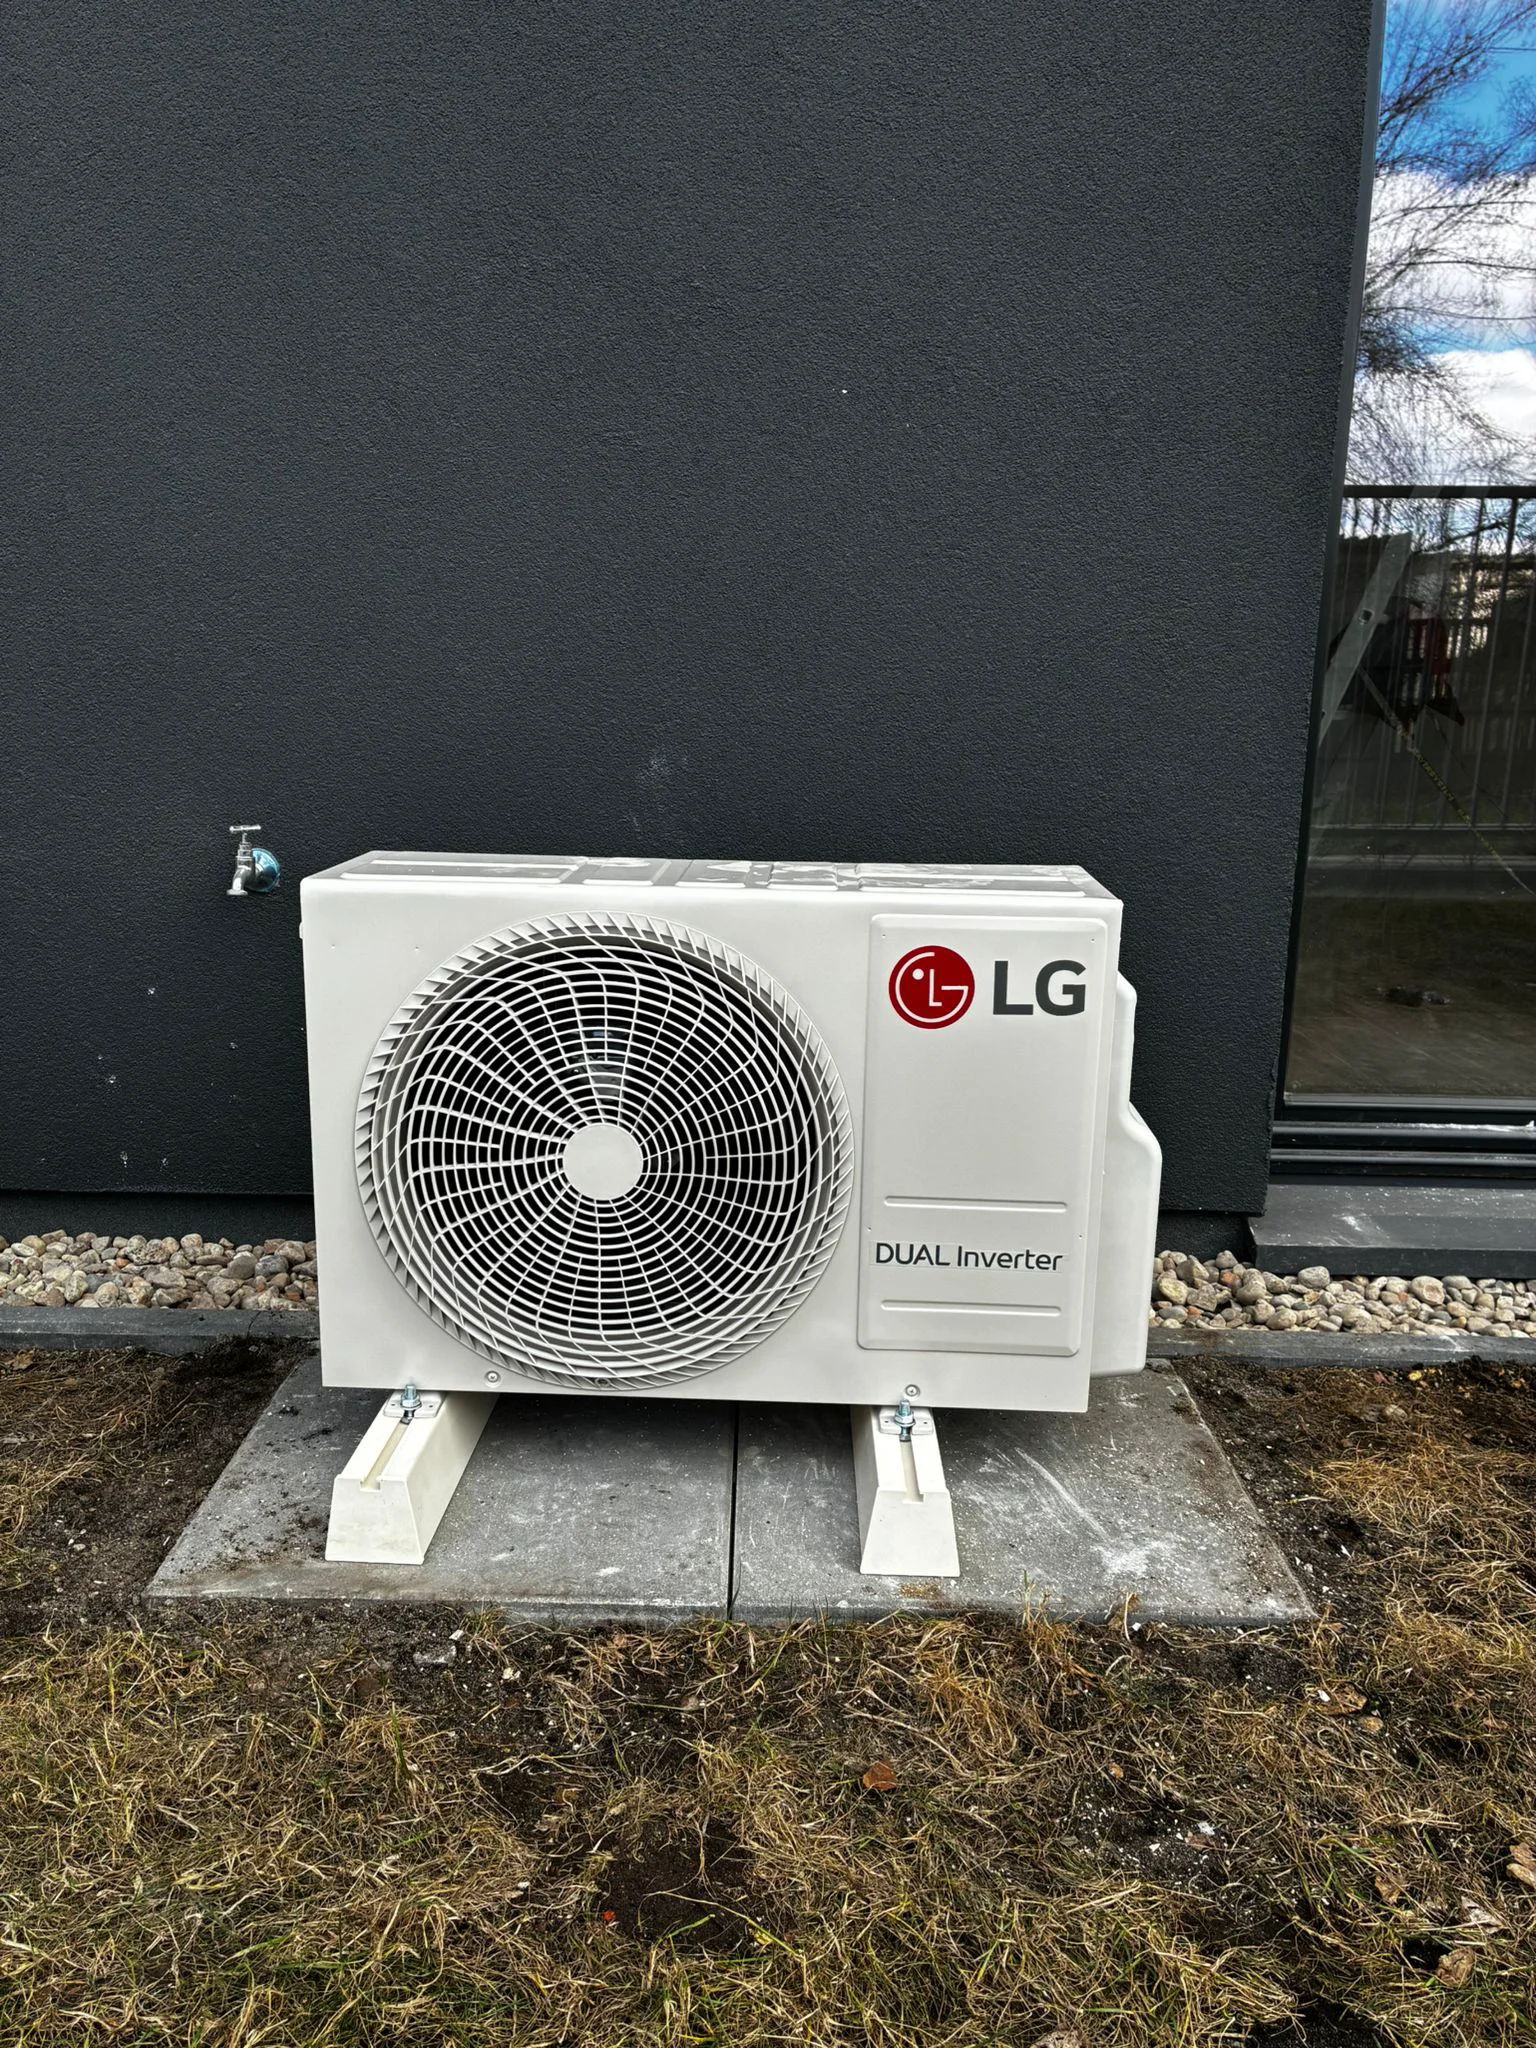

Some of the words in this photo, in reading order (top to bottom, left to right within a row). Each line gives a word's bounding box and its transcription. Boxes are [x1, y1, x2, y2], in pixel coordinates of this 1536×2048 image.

[993, 959, 1087, 1017] LG
[875, 1242, 951, 1267] DUAL
[957, 1245, 1064, 1272] Inverter
